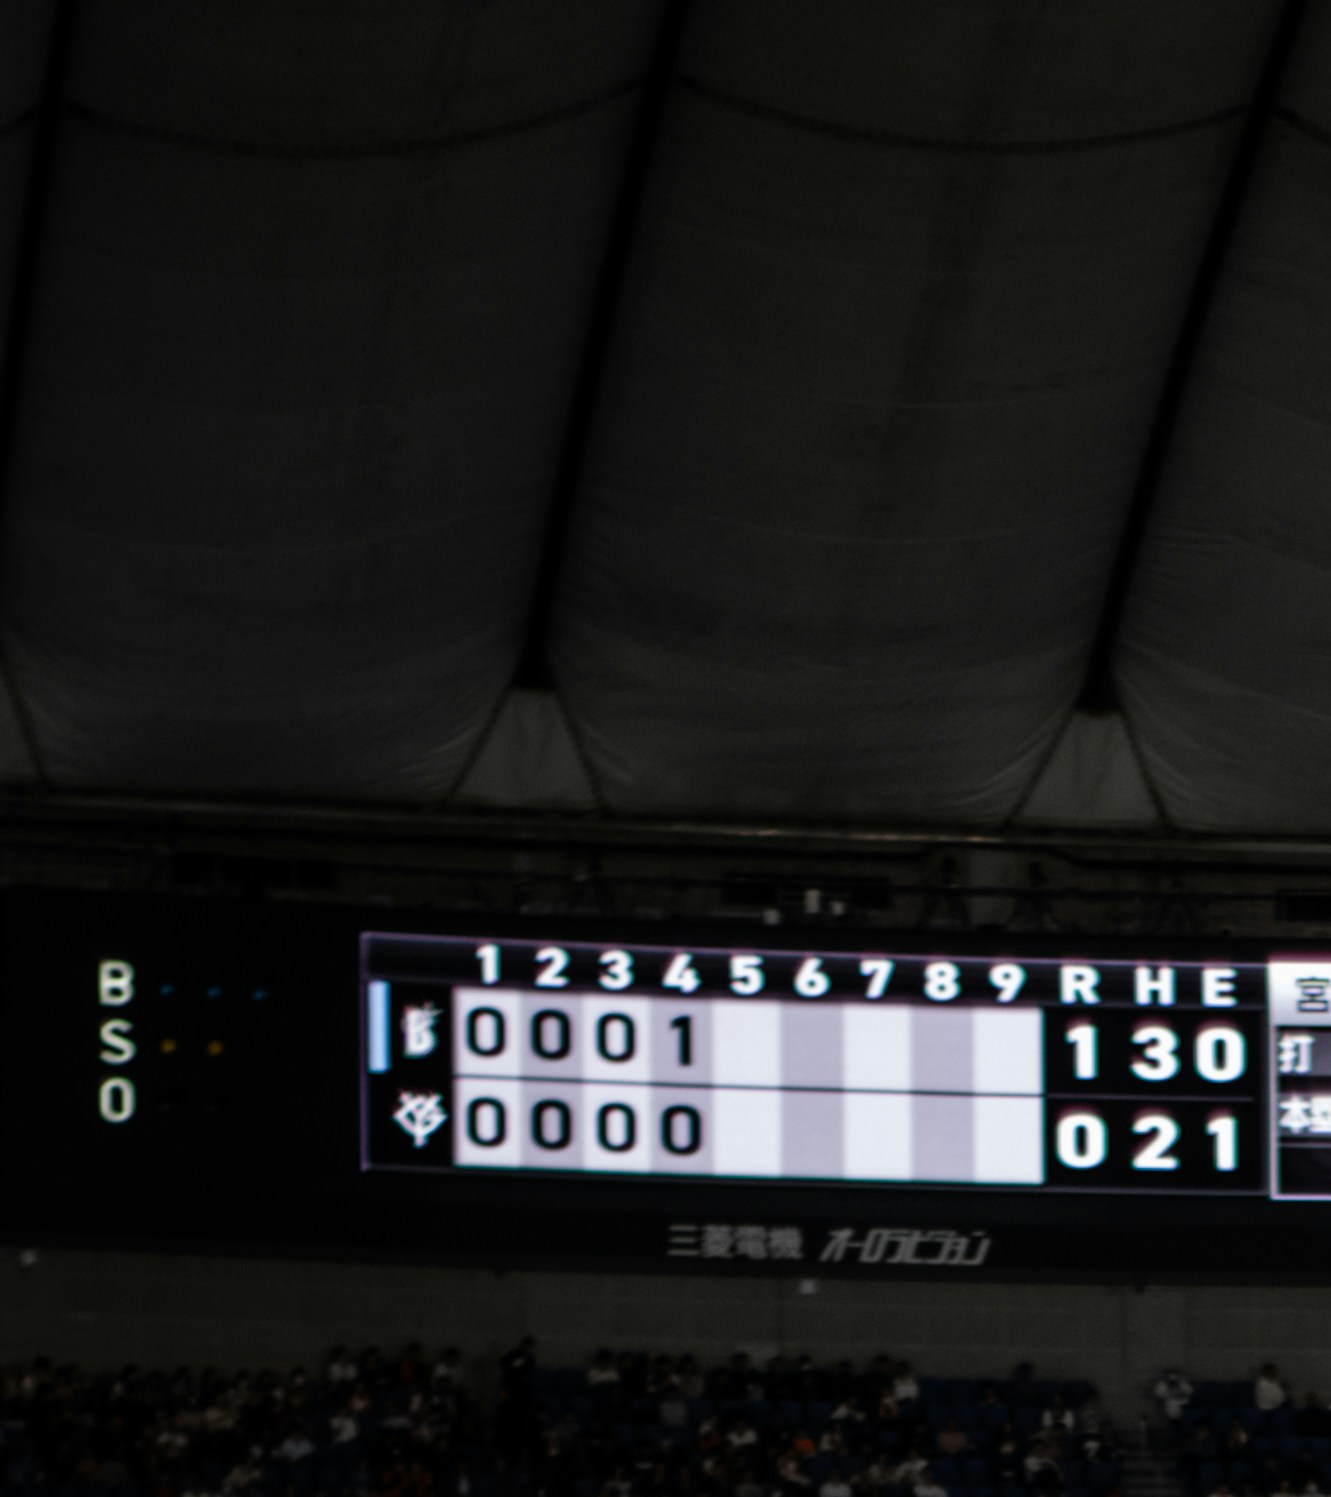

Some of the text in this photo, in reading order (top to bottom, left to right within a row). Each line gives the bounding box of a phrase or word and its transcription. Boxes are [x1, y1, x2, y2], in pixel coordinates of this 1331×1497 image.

[98, 961, 135, 1006] B
[476, 944, 1238, 1008] 1 2 3 4 5 6 7 8 9 R H E
[99, 1020, 136, 1064] S
[465, 1007, 1248, 1083] 0 0 0 1 1 3 0
[465, 1096, 1238, 1171] 0 0 0 0 0 2 1
[665, 1224, 803, 1260] 三菱電機
